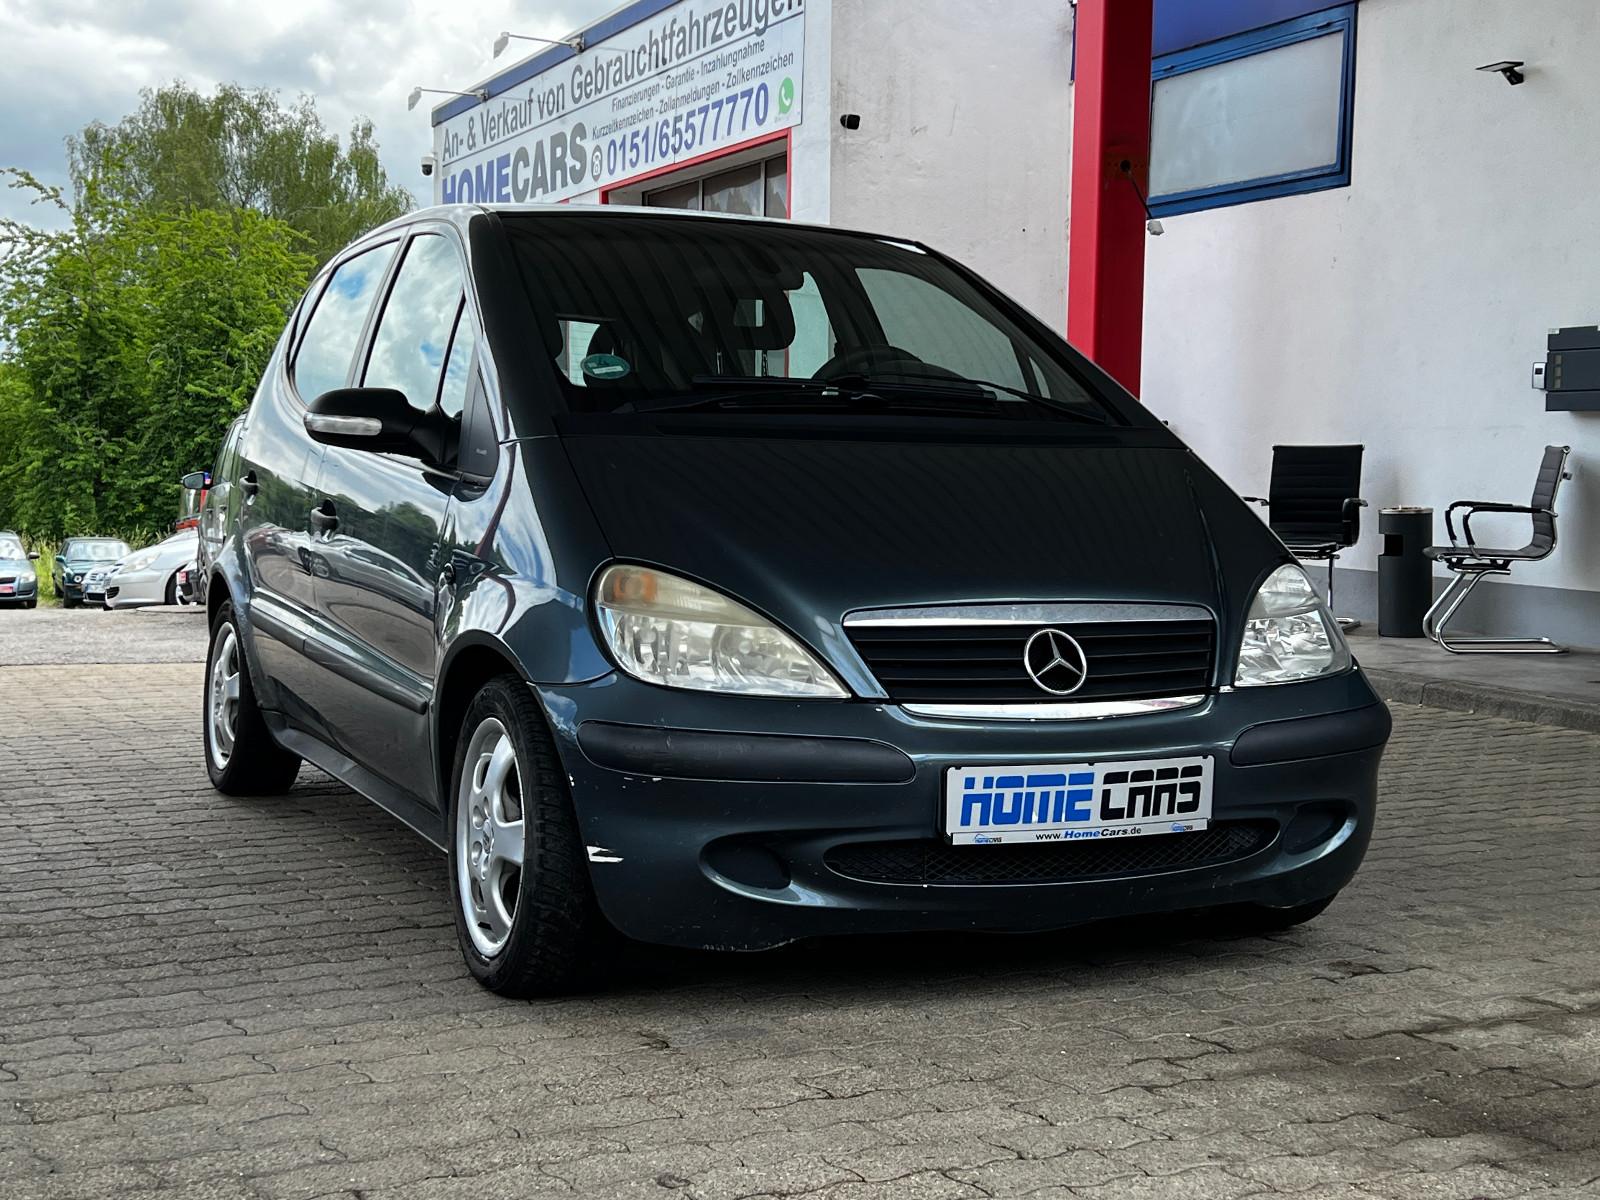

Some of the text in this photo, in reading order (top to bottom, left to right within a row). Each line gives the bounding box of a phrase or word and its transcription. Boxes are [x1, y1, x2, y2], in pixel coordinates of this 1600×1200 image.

[592, 107, 654, 140] Kurzzeitkennzeichen
[659, 81, 720, 115] Zollanmeldungen
[727, 51, 794, 88] Zollkennzeichen
[611, 83, 660, 112] Finanzierungen
[666, 67, 694, 90] Garantie
[701, 39, 765, 76] Inzahlungnahme
[442, 128, 463, 161] An-
[467, 116, 476, 151] &
[480, 87, 533, 144] Verkauf
[538, 82, 564, 120] von
[607, 82, 769, 176] 0151/65577770
[960, 765, 1202, 826] HOME CARS
[1036, 826, 1142, 840] www.HomeCars.de
